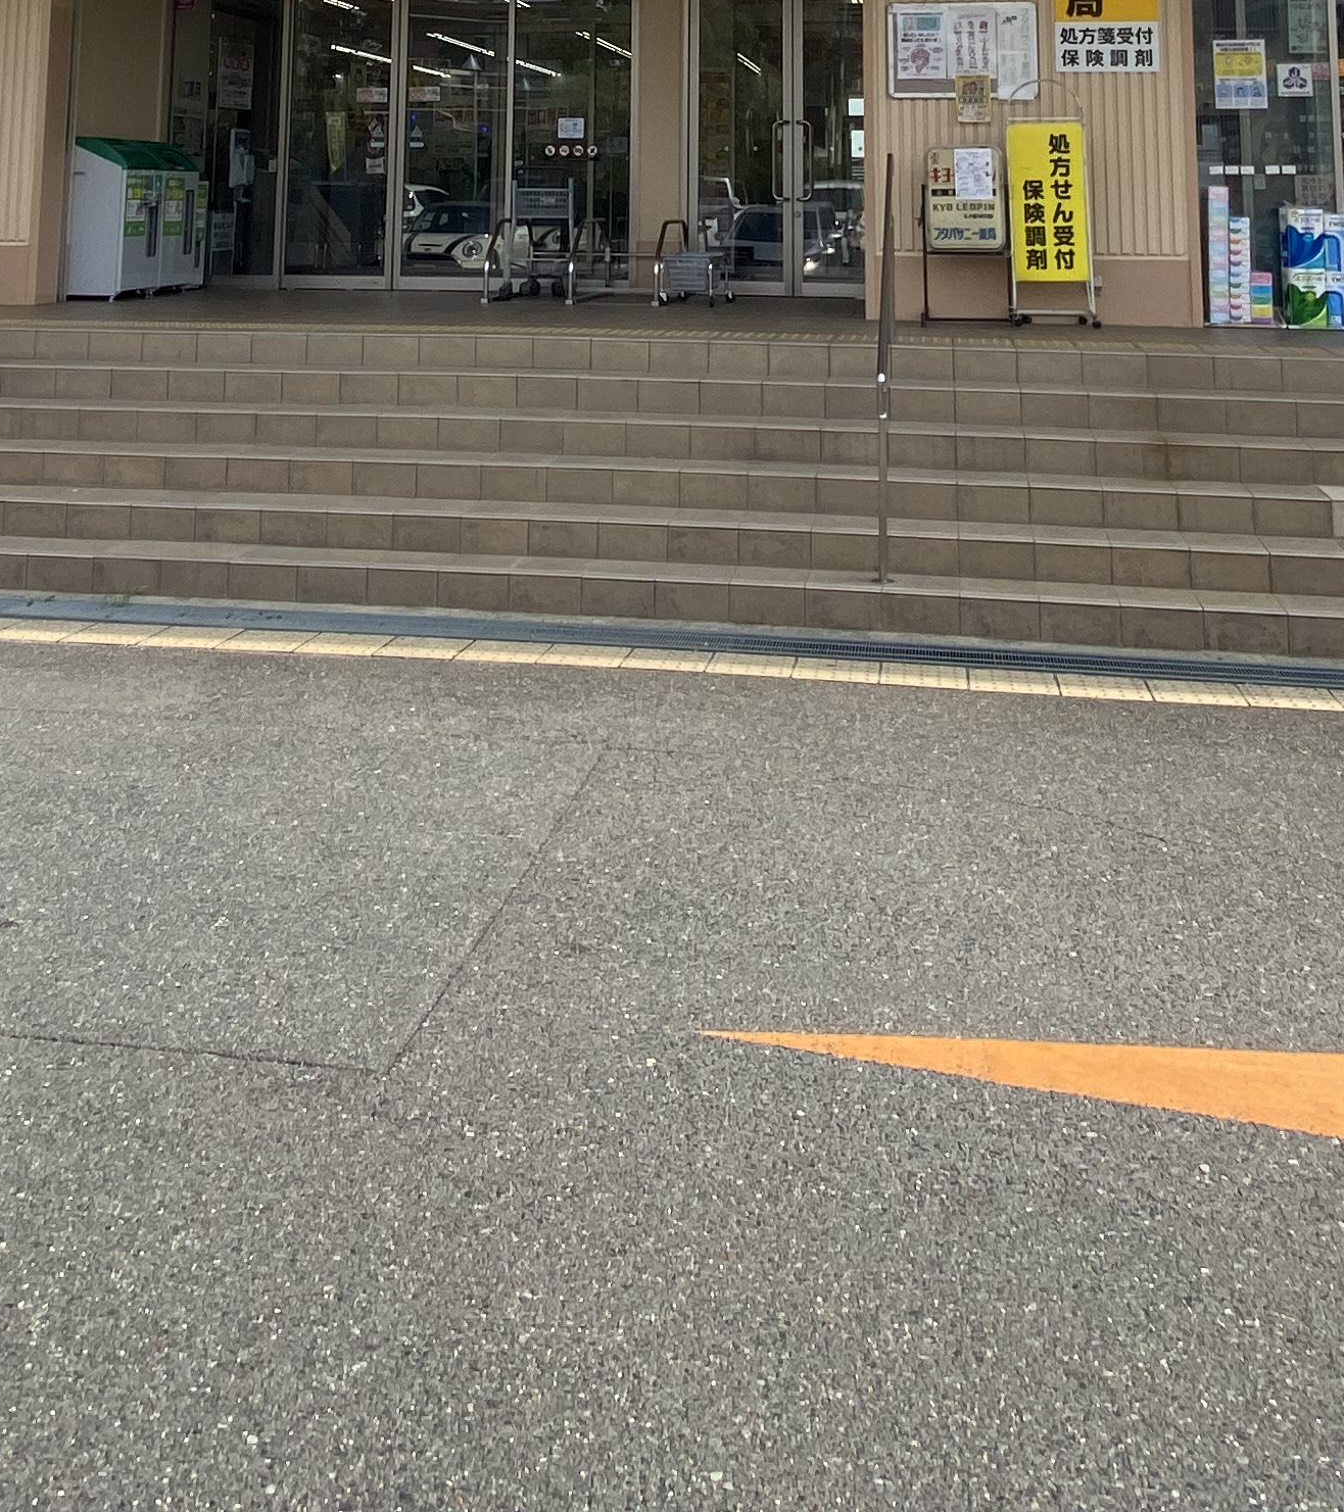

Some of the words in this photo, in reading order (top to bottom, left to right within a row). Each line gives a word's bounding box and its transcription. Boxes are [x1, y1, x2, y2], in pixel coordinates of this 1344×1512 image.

[1059, 26, 1154, 46] 処方箋受付
[1060, 48, 1153, 68] 保険調剤
[1022, 179, 1048, 271] 保険調剤
[1047, 133, 1076, 271] 処方せん受付
